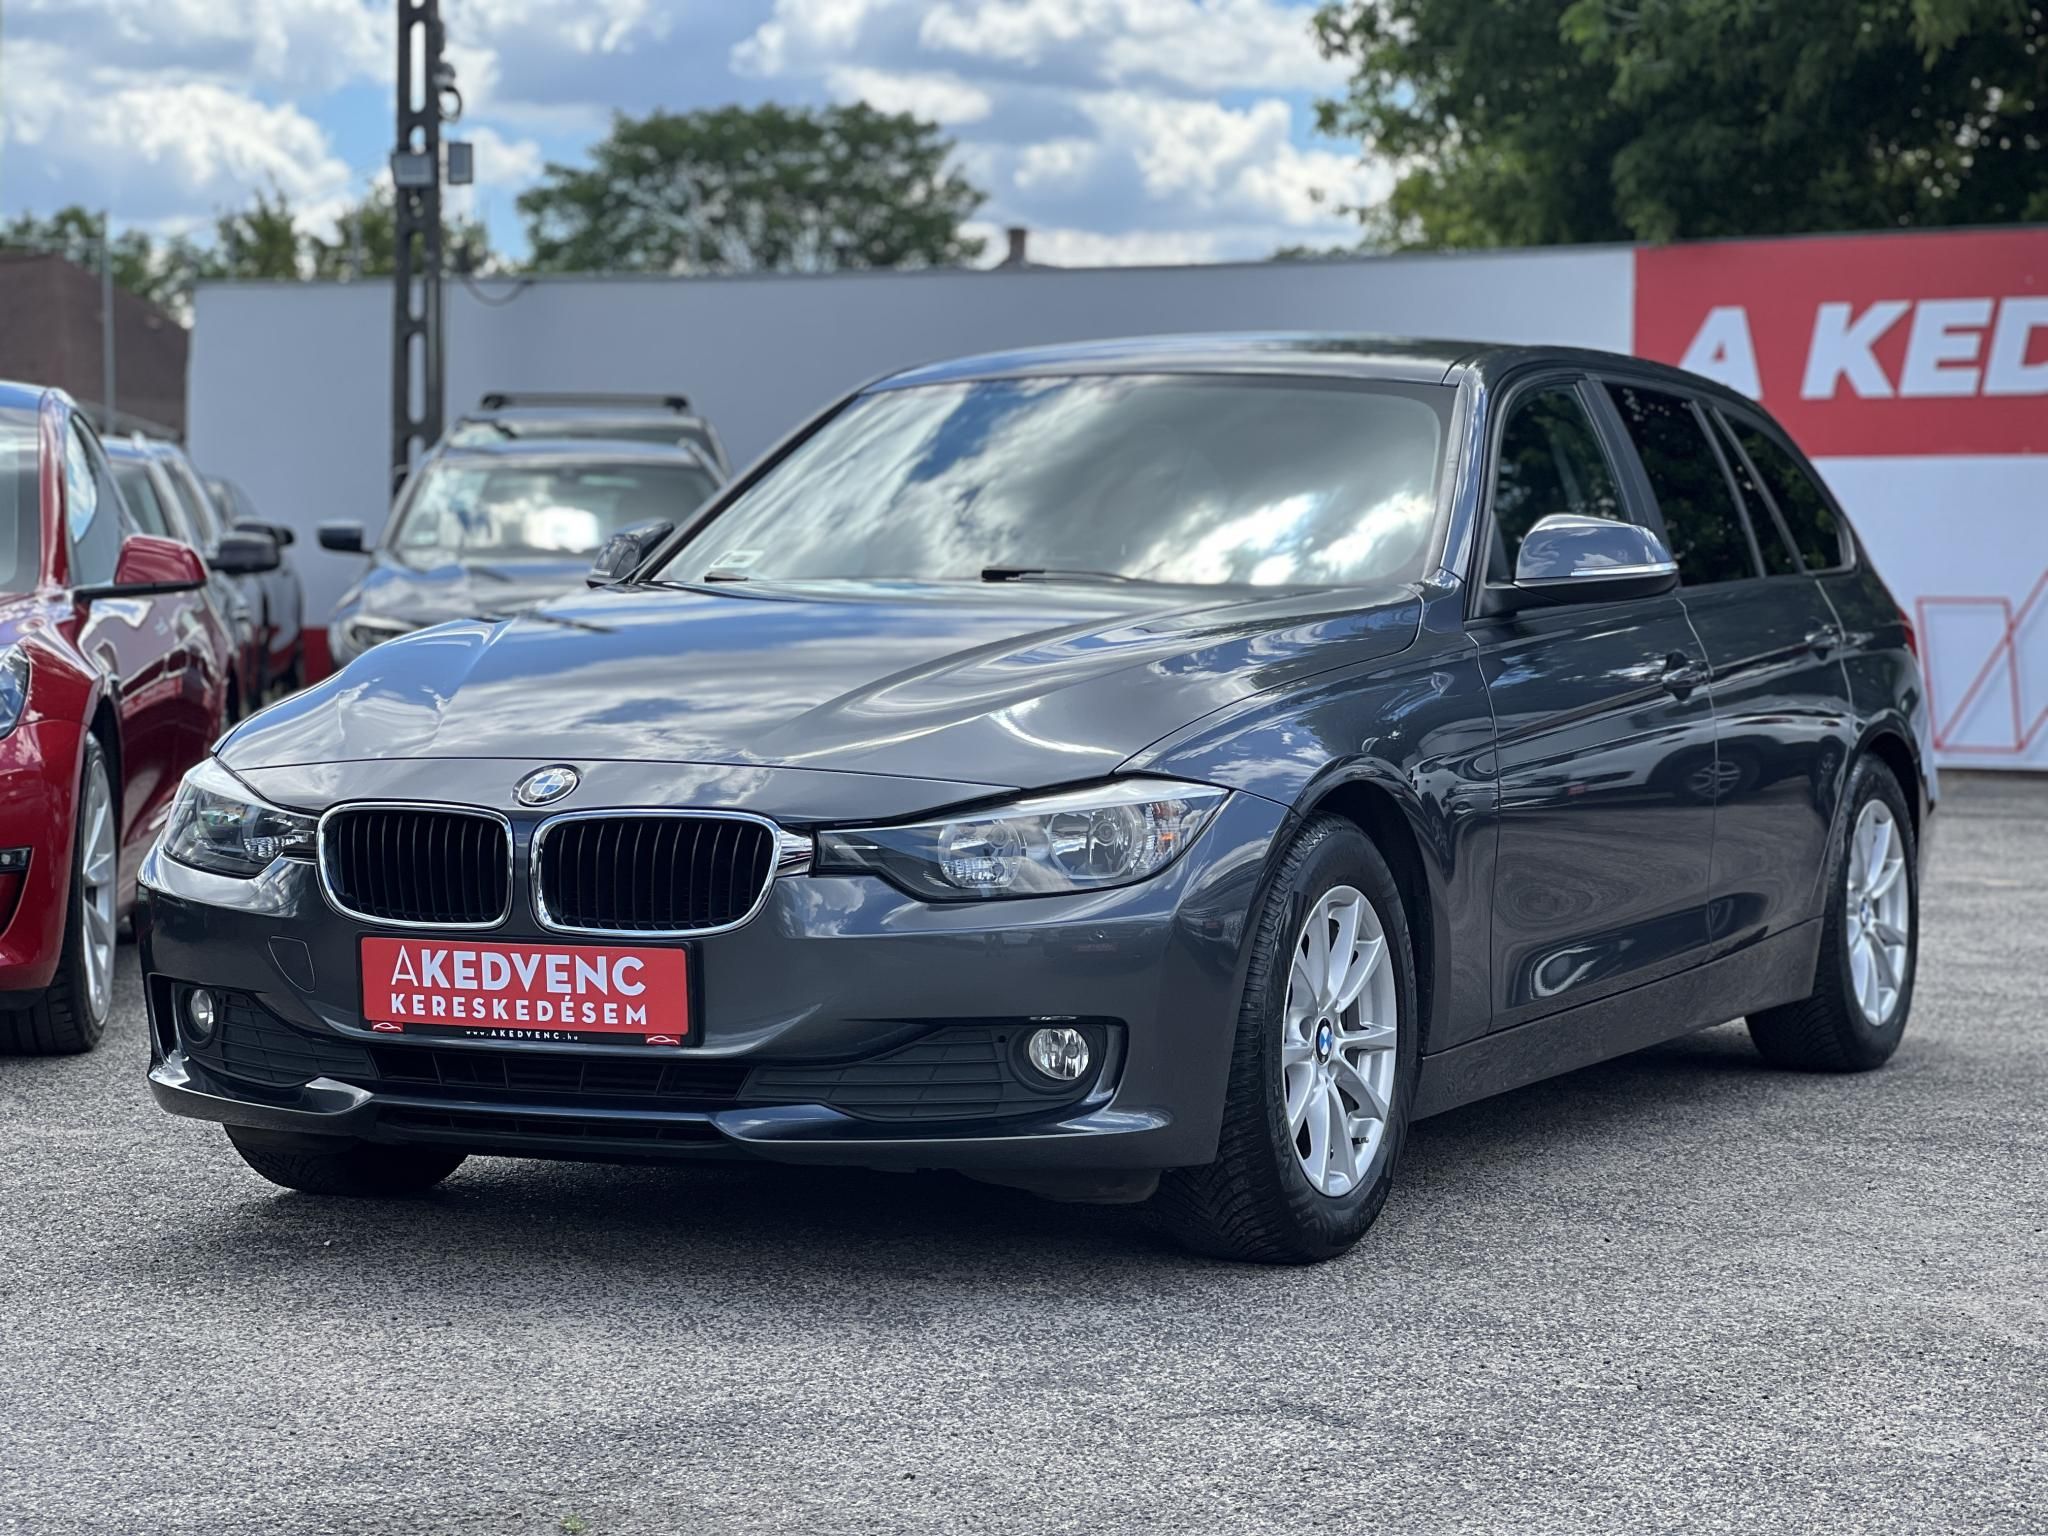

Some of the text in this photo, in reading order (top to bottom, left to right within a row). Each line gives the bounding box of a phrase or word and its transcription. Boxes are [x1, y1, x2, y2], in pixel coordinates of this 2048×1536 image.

[1678, 296, 2048, 400] A KED
[390, 944, 647, 997] AKEDVENC
[390, 993, 647, 1025] KERESKEDÉSEM
